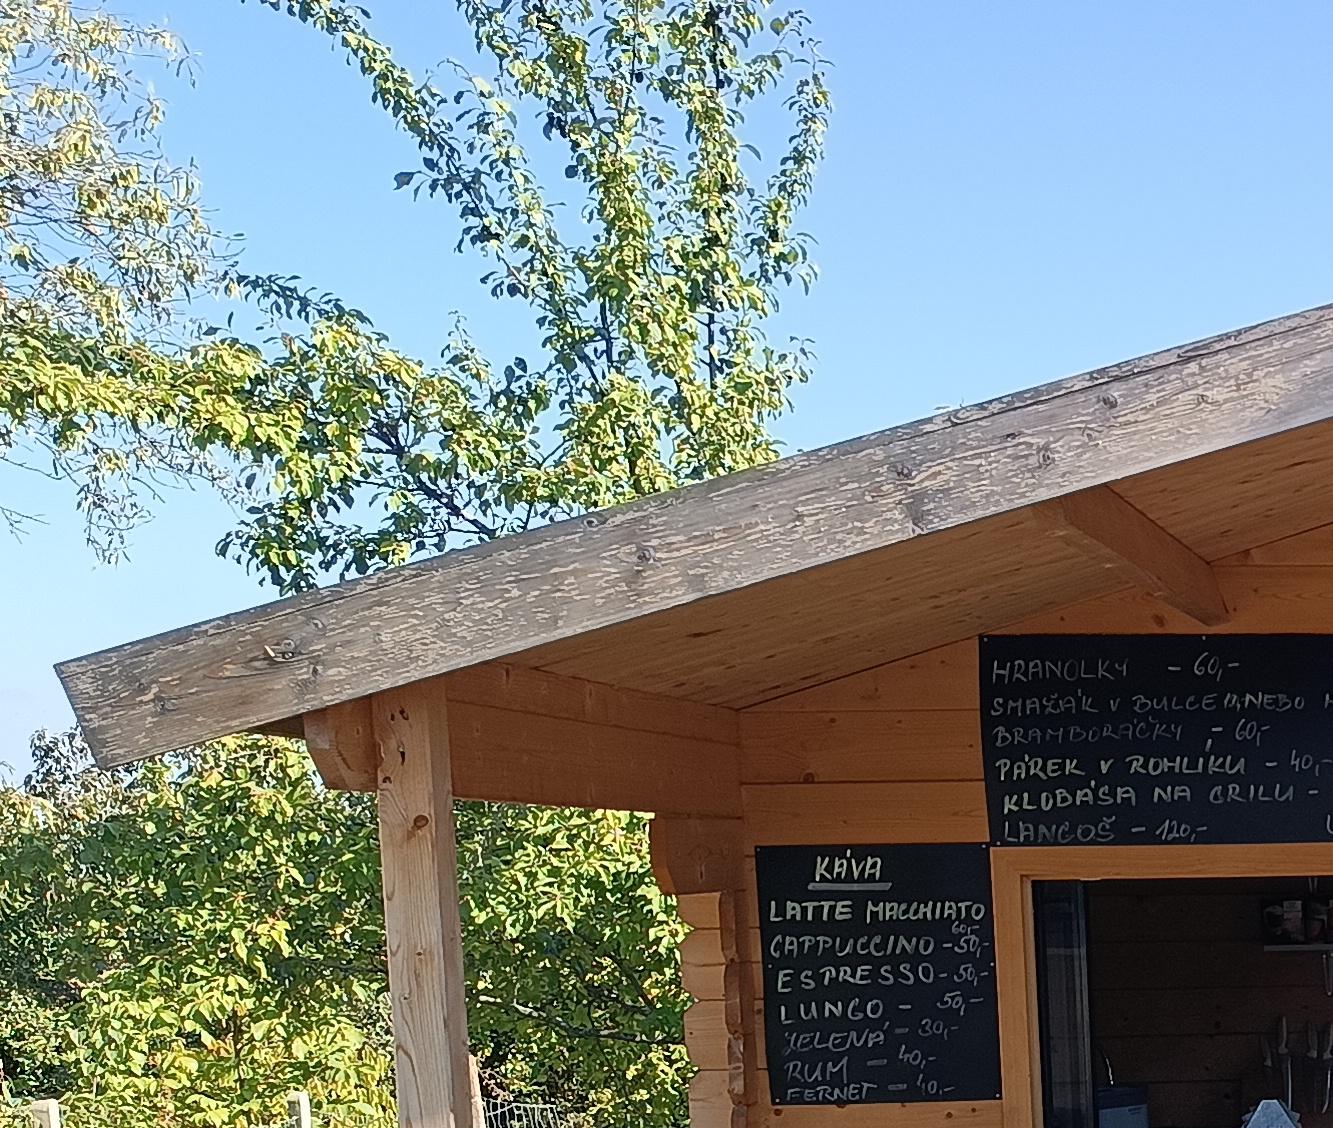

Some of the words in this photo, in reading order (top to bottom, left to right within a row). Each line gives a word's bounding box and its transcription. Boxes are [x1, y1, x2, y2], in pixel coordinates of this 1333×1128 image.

[993, 659, 1128, 684] HRANOLKY
[1194, 652, 1239, 681] 60,-
[991, 689, 1099, 716] SMAŽÁK
[1132, 693, 1218, 712] BULCE
[992, 717, 1183, 747] BRAMBORÁČKY
[1235, 718, 1270, 746] 60,-
[995, 753, 1086, 781] PÁREK
[1125, 738, 1246, 775] ROHLÍKU
[1290, 750, 1333, 778] 40,-
[1003, 780, 1136, 815] KLOBÁSA
[1153, 785, 1191, 803] NA
[1209, 784, 1294, 804] GRILU
[1003, 816, 1116, 844] LANGOŠ
[1155, 819, 1208, 842] 120,-
[815, 849, 882, 882] KÁVA
[769, 900, 853, 922] LATTE
[866, 900, 986, 924] MACCHIATO
[770, 934, 935, 958] CAPPUCCINO
[777, 963, 934, 993] ESPRESSO
[780, 998, 883, 1024] LUNGO
[918, 1018, 959, 1040] 30,-
[785, 1056, 848, 1084] RUM
[899, 1044, 936, 1069] 40,-
[787, 1082, 877, 1101] FERNET
